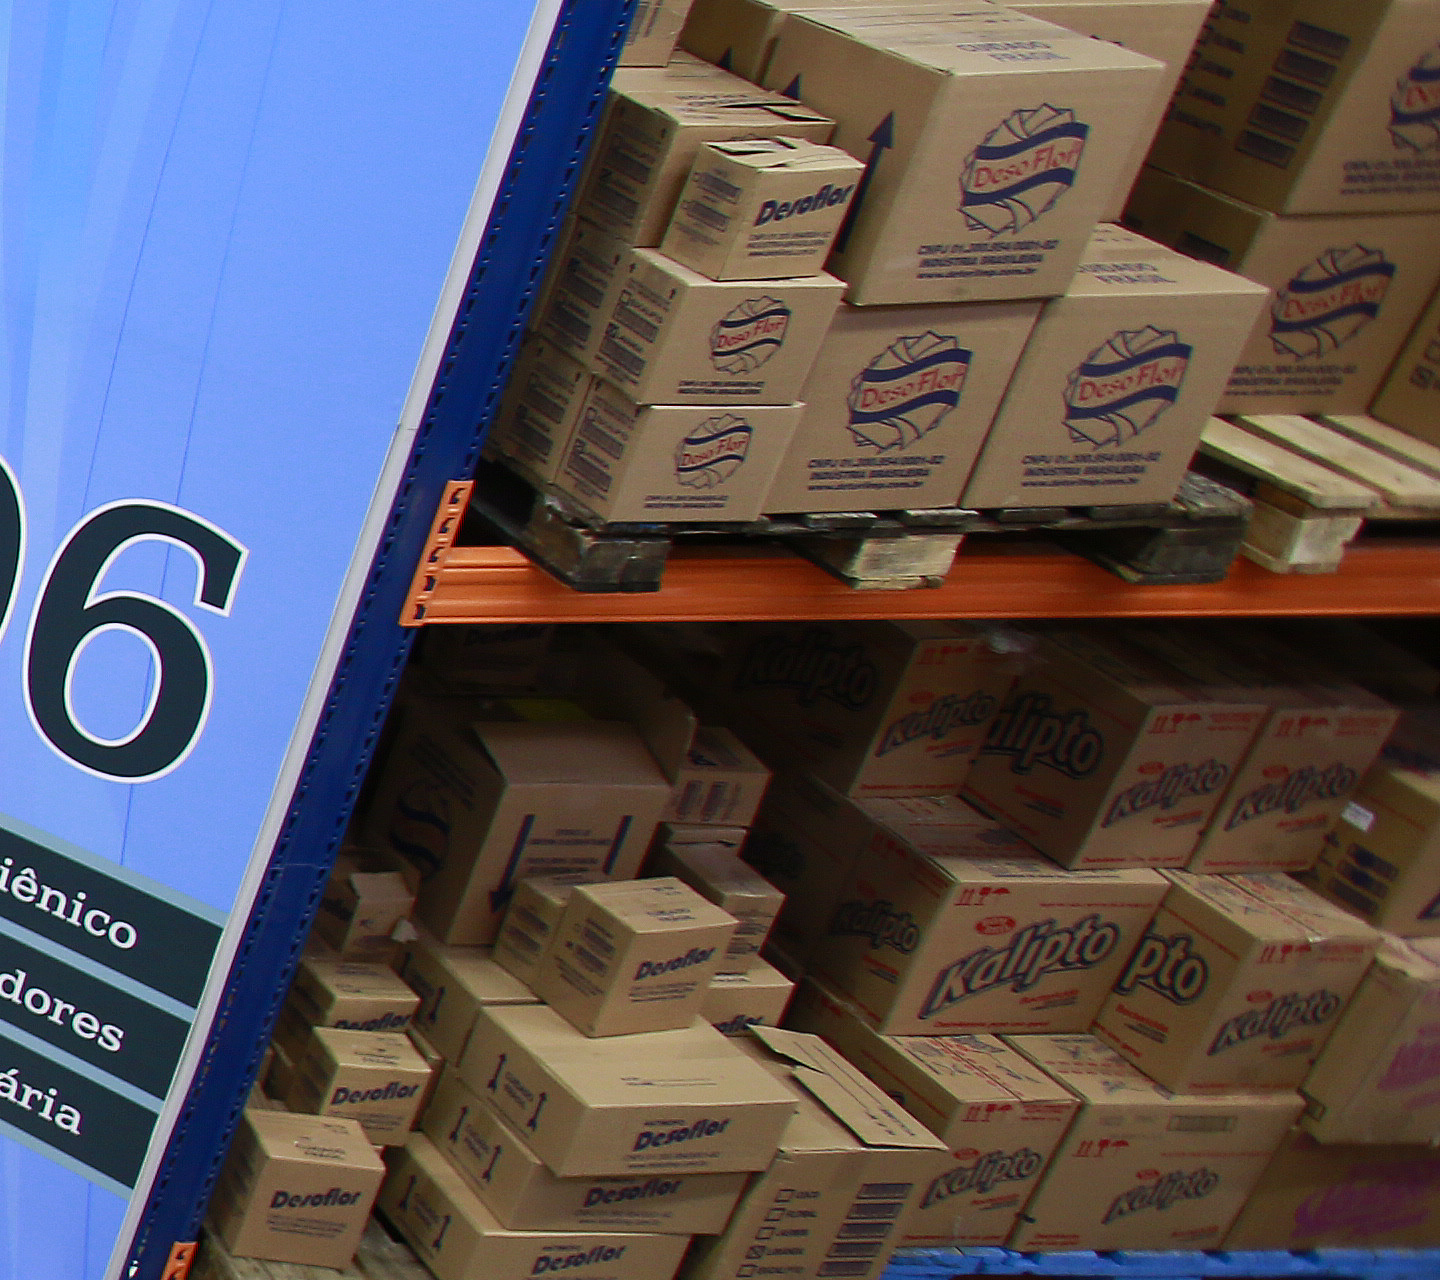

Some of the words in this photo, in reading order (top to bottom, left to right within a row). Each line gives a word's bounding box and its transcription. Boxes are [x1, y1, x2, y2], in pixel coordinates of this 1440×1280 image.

[754, 184, 856, 228] Desoflor
[876, 688, 996, 758] Kalipto
[1105, 760, 1232, 827] Kalipto
[1227, 763, 1356, 830] Kalipto
[634, 946, 718, 982] Desoflor
[920, 910, 1124, 1018] Kalipto
[1208, 990, 1347, 1054] Kalipto
[331, 1081, 421, 1106] Desoflor
[633, 1118, 731, 1153] Desoflor
[270, 1187, 362, 1211] Desoflor
[584, 1179, 684, 1209] Desoflor
[919, 1146, 1045, 1208] Kalipto
[1102, 1166, 1223, 1226] Kalipto
[531, 1244, 627, 1276] Desoflor
